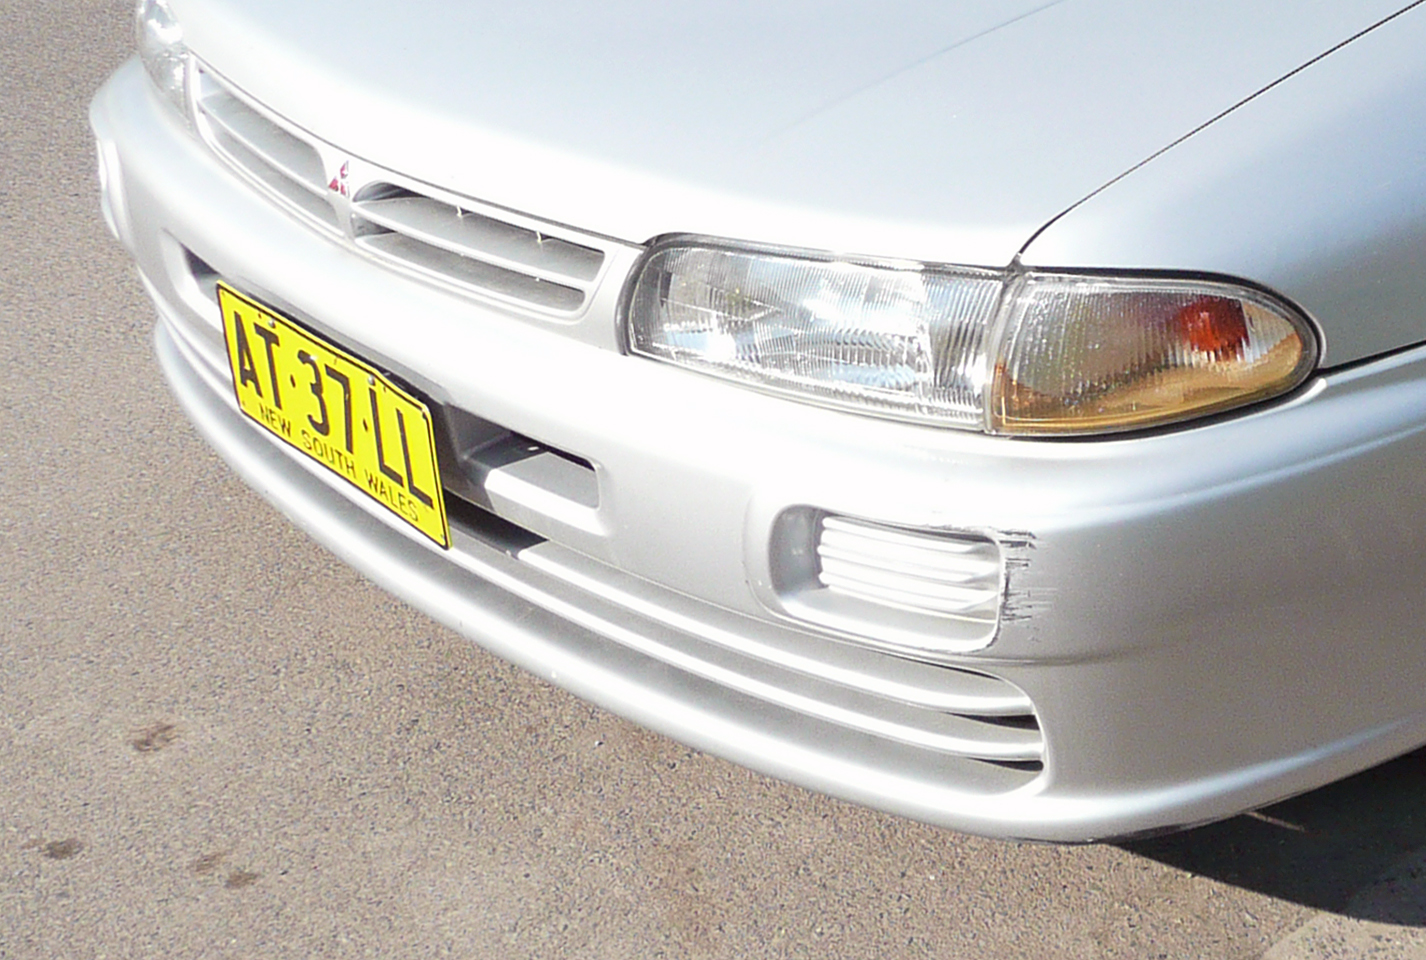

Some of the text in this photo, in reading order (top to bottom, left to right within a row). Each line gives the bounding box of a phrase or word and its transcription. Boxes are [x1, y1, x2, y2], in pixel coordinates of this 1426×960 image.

[259, 404, 419, 523] NEW SOUTH WALES
